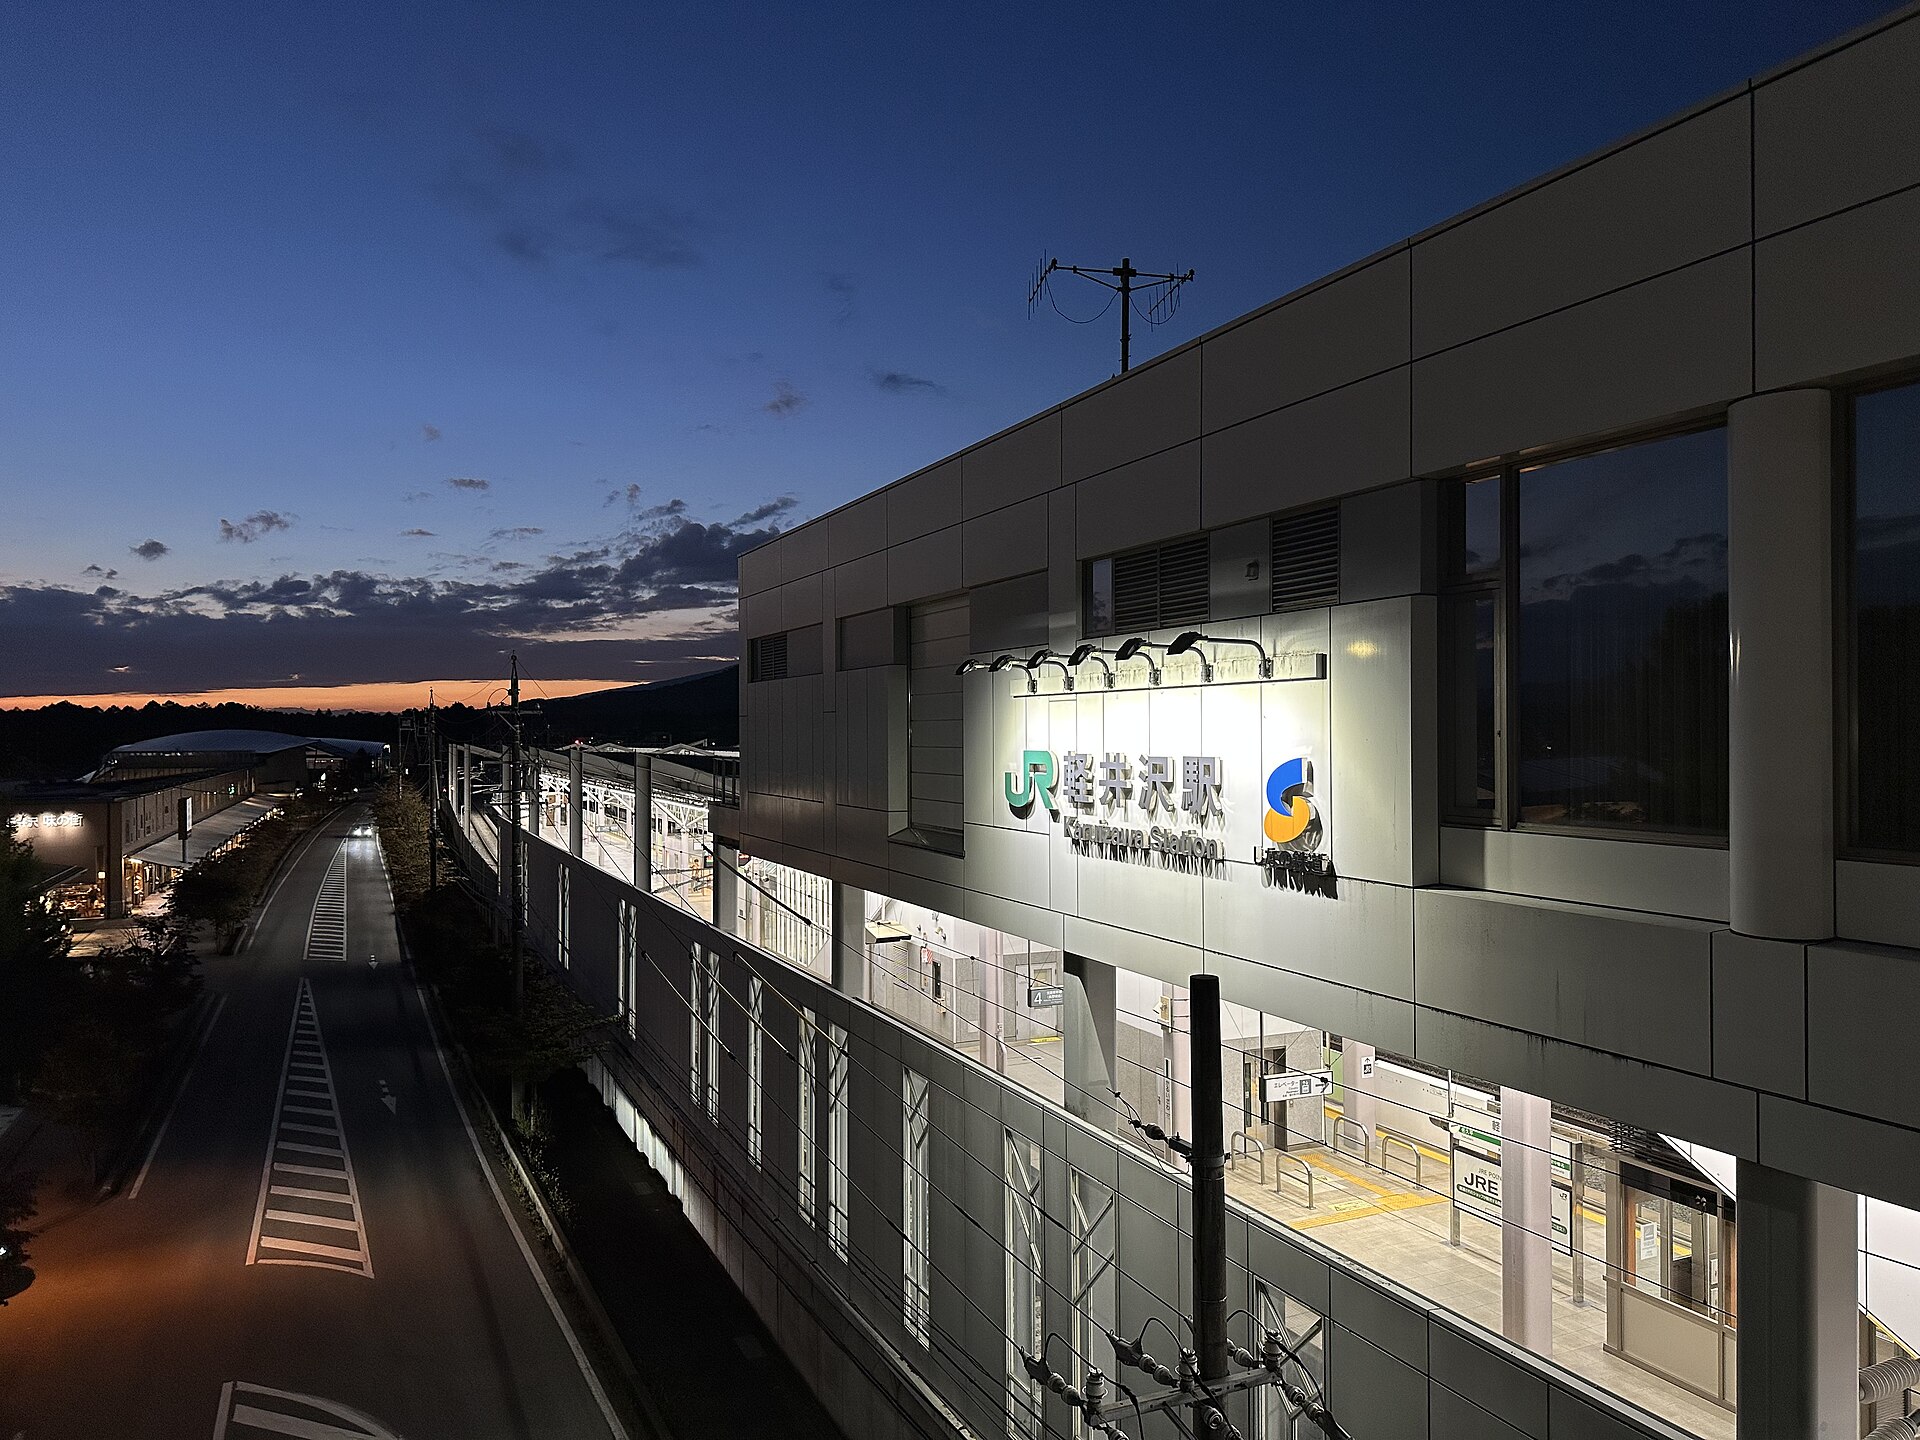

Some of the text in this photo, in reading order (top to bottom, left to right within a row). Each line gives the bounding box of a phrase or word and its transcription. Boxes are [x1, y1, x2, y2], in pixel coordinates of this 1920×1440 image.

[1004, 750, 1221, 818] JR 軽井沢駅
[1063, 815, 1222, 860] Karuizawa Station
[1033, 991, 1043, 1004] 4
[1463, 1172, 1499, 1197] JRE
